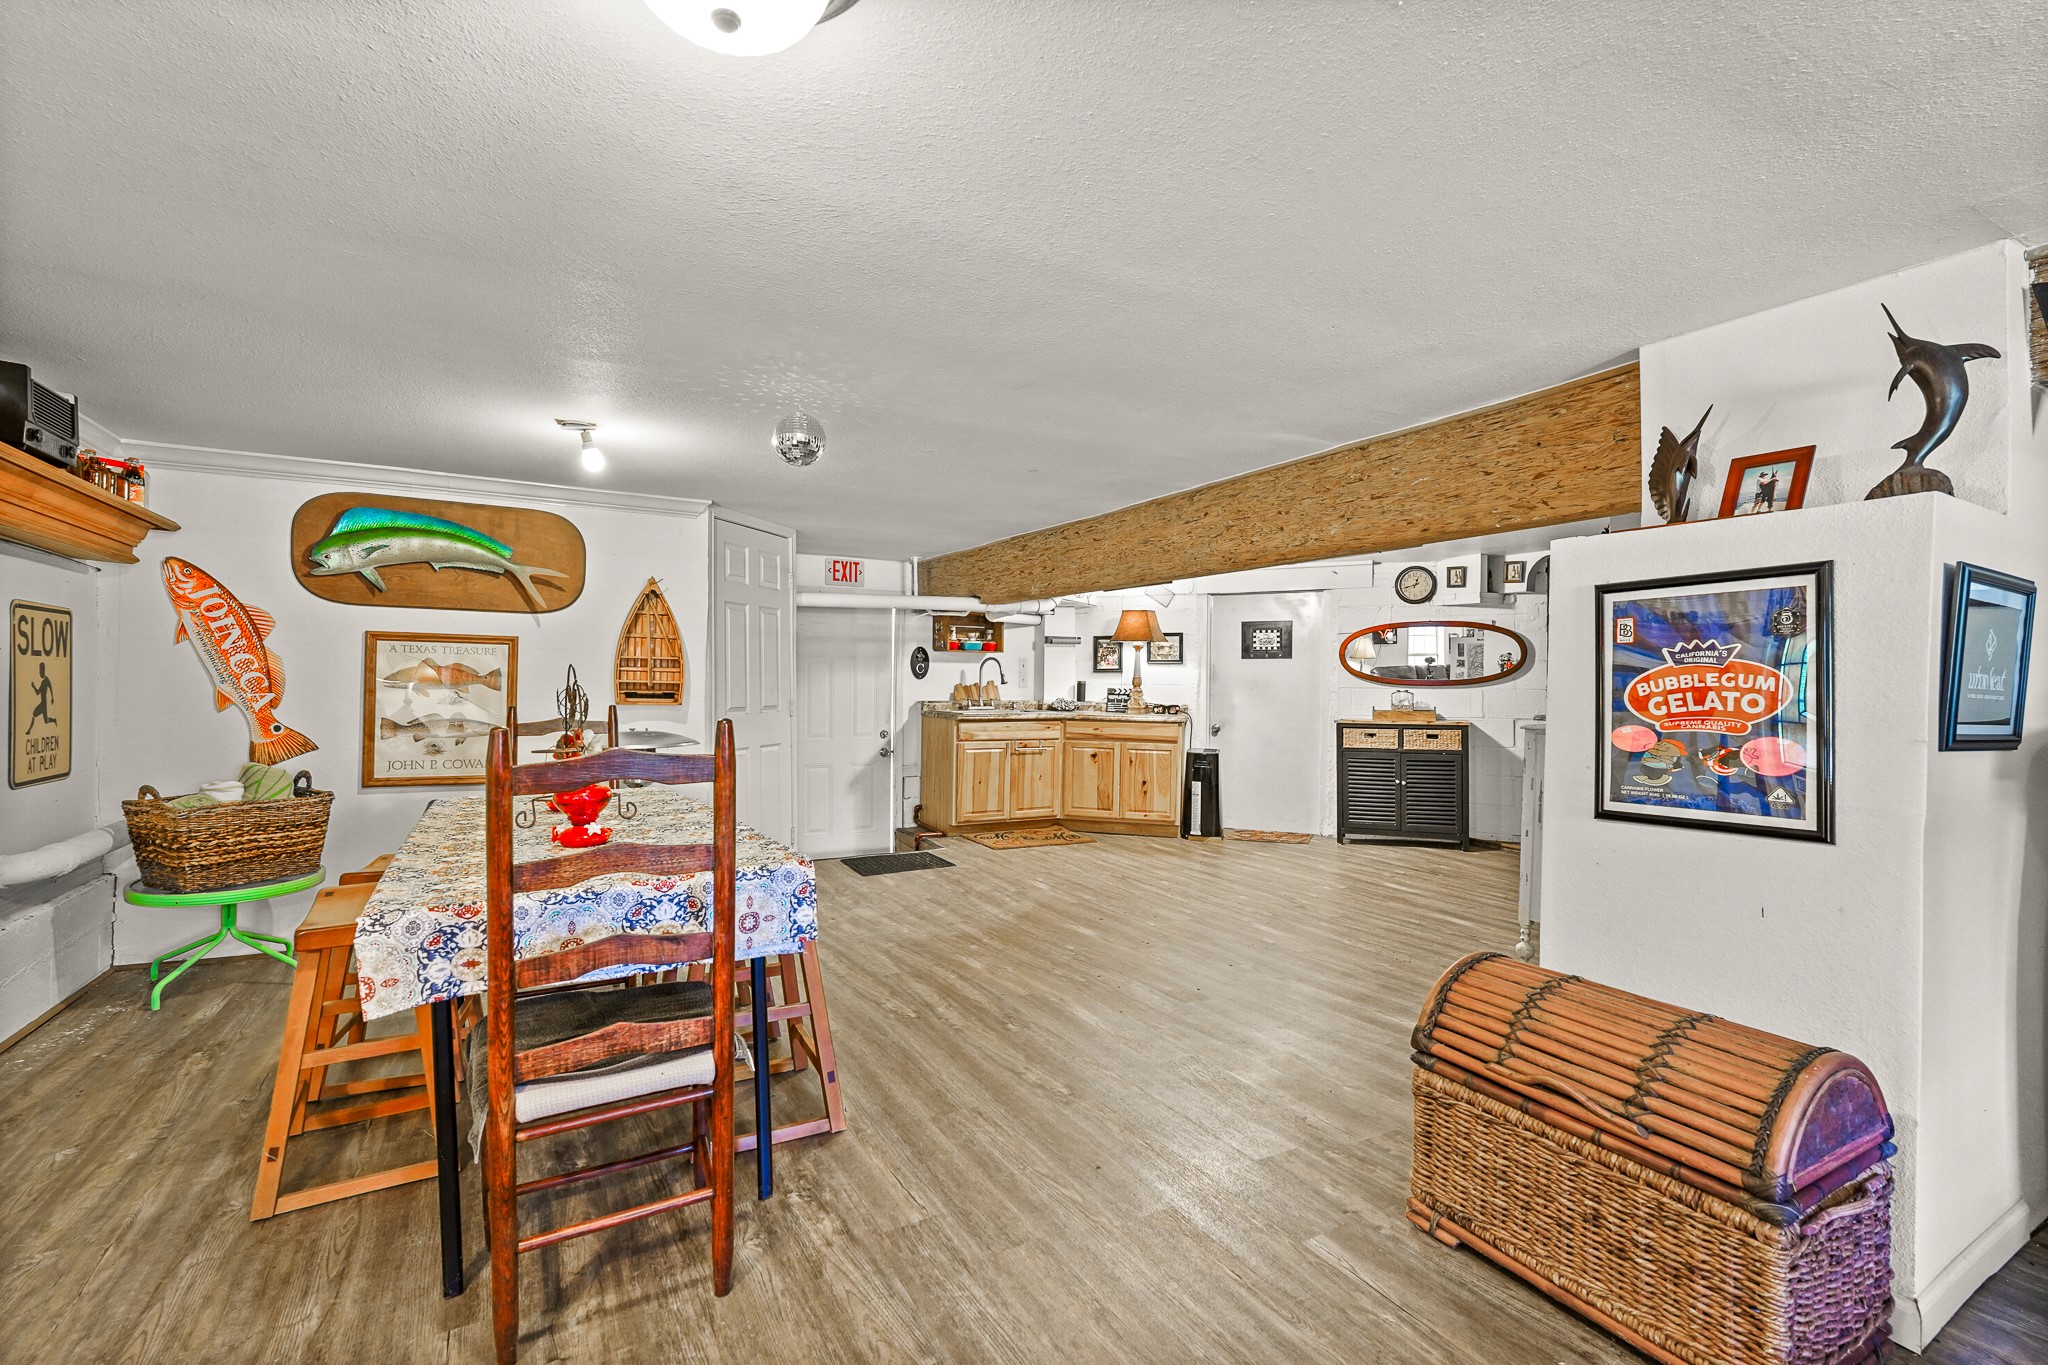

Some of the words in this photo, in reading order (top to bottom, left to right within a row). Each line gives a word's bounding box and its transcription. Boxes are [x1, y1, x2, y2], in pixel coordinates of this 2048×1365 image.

[832, 560, 860, 583] EXIT
[17, 614, 69, 658] SLOW
[185, 583, 248, 650] JOIN
[229, 653, 276, 712] CCA
[195, 630, 226, 685] www.joincca.org
[389, 644, 398, 653] A
[400, 644, 437, 654] TEXAS
[440, 645, 497, 656] TREASURE
[1675, 649, 1728, 659] CALIFORNIA'S
[915, 662, 925, 674] C
[1684, 656, 1718, 664] ORIGINAL
[1635, 672, 1776, 697] BUBBLEGUM
[1647, 690, 1766, 716] GELATO
[1663, 719, 1703, 727] SUPREME
[1703, 719, 1742, 728] QUALITY
[1680, 724, 1727, 732] CANNABIS
[25, 735, 60, 756] CHILDREN
[27, 756, 36, 775] AT
[39, 752, 57, 772] PLAY
[386, 760, 425, 773] JOHN
[429, 760, 438, 770] P.
[442, 759, 486, 769] COWA
